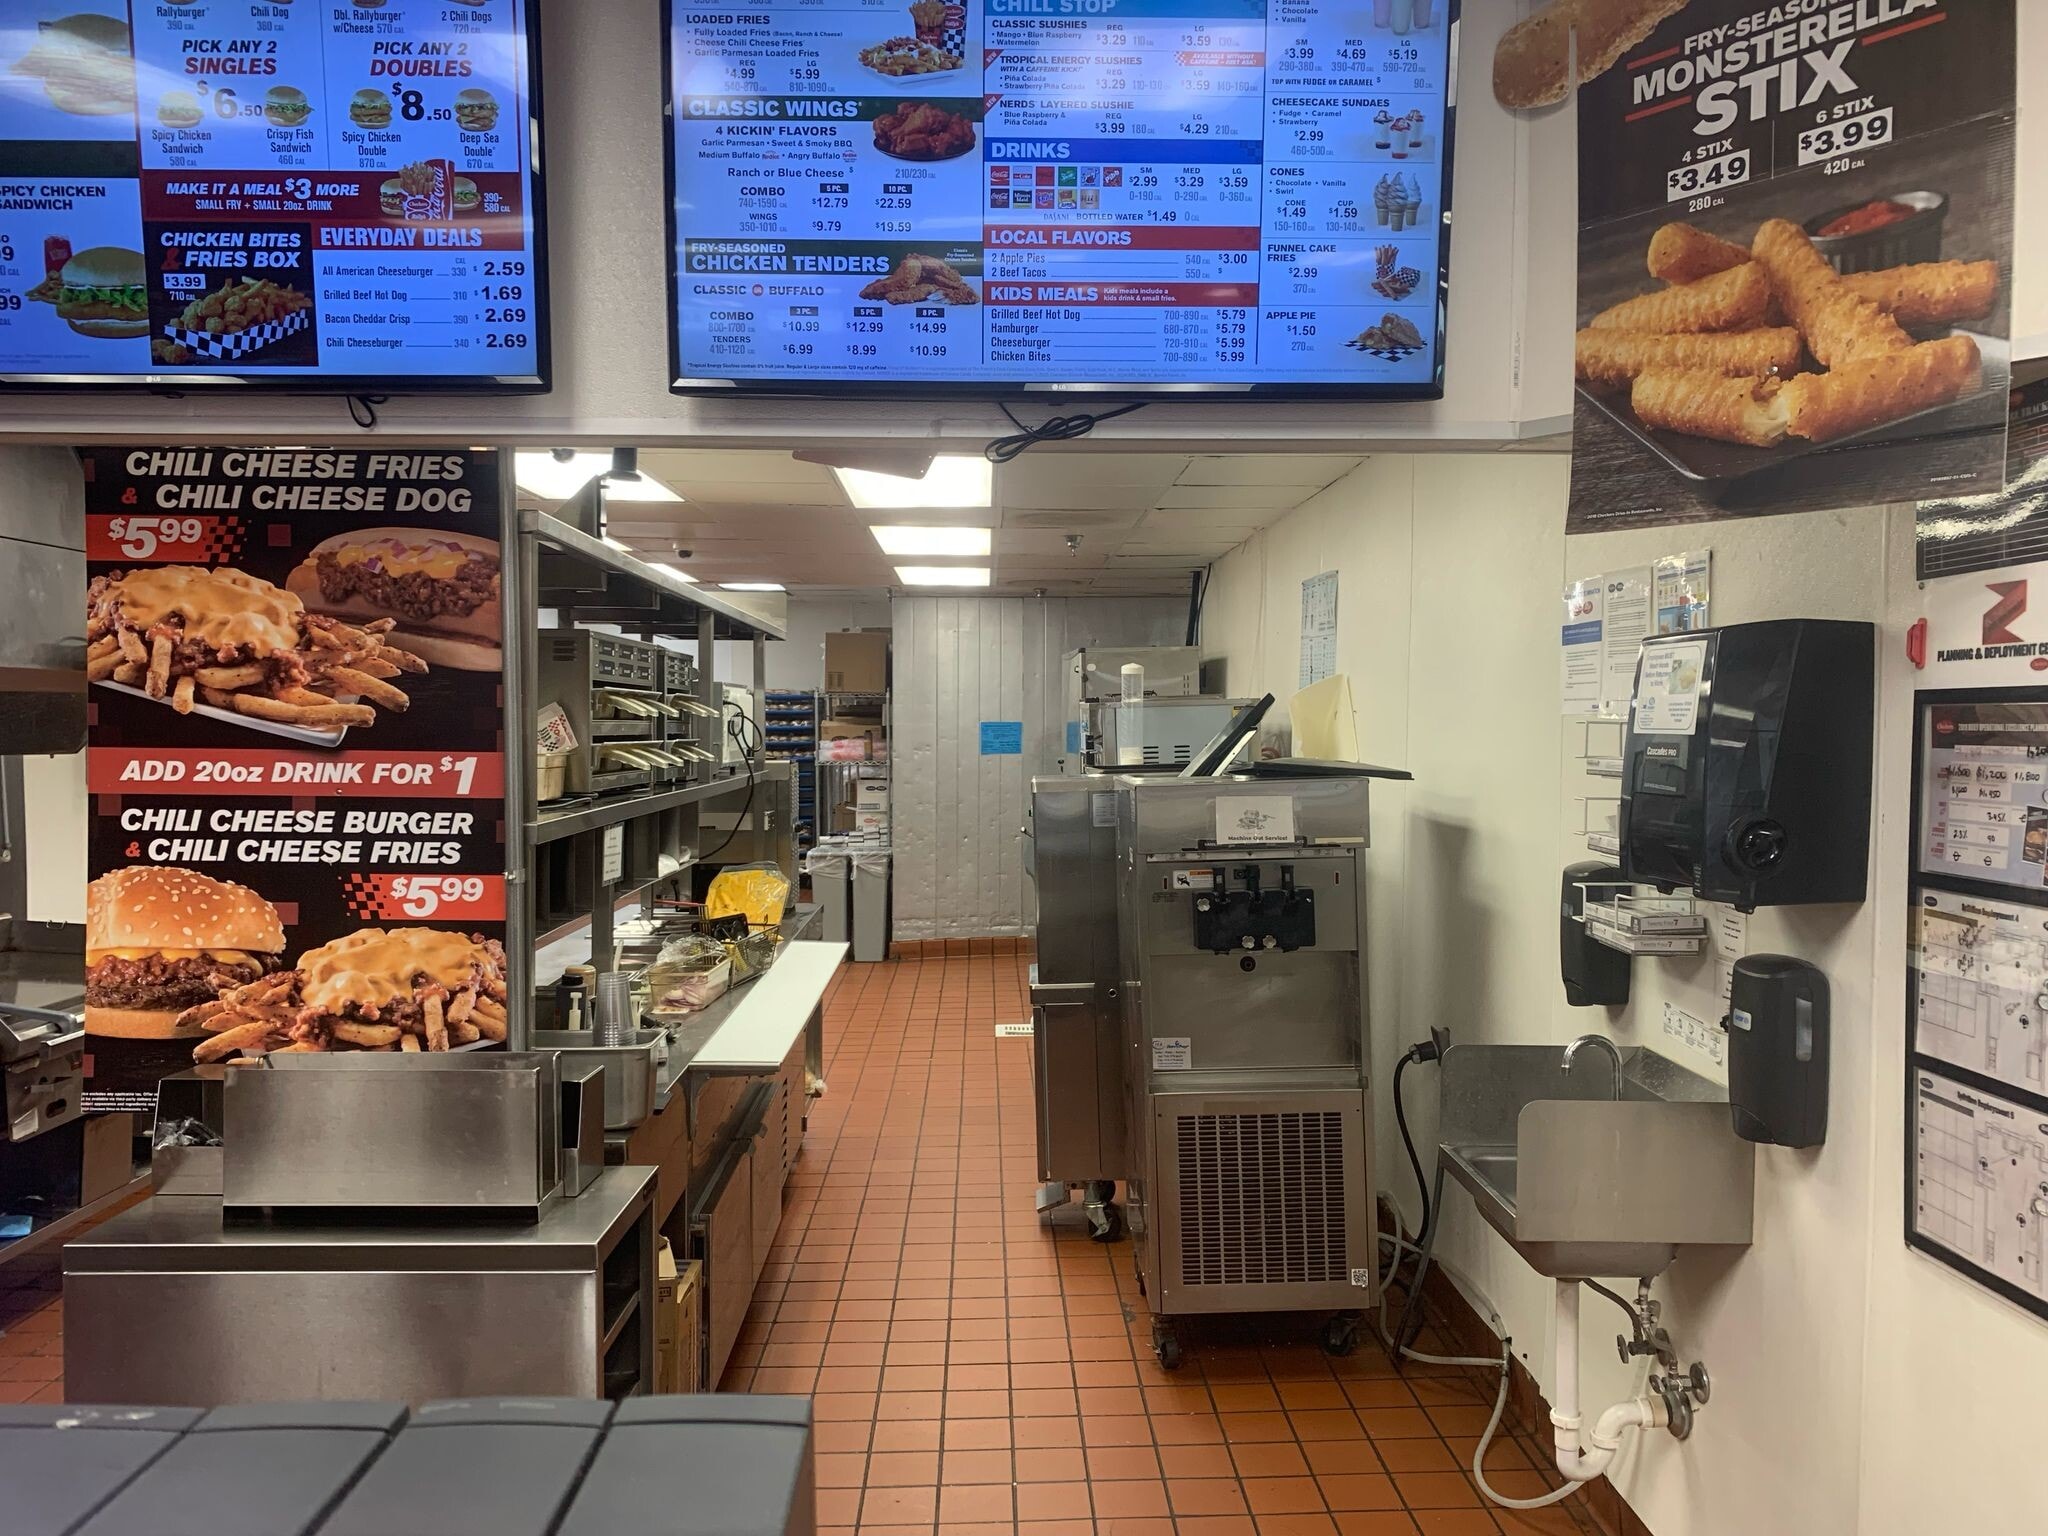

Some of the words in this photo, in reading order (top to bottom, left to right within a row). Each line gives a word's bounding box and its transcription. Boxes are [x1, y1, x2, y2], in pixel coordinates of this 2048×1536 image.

[993, 0, 1053, 12] CHILL
[1060, 0, 1115, 13] STOP
[687, 15, 734, 25] LOADED
[737, 15, 770, 25] FRIES
[992, 20, 1036, 29] CLASSIC
[1039, 20, 1087, 29] SLUSHIES
[717, 29, 748, 37] Loaded
[750, 29, 771, 37] Fries
[182, 40, 224, 53] PICK
[230, 41, 262, 53] ANY
[267, 41, 277, 53] 2
[373, 42, 413, 55] PICK
[418, 42, 453, 55] ANY
[456, 43, 468, 55] 2
[766, 49, 797, 57] Loaded
[185, 57, 277, 75] SINGLES
[370, 59, 473, 77] DOUBLES
[1692, 39, 1858, 136] STIX
[689, 100, 780, 117] CLASSIC
[1272, 98, 1339, 106] CHEESECAKE
[1342, 99, 1389, 107] SUNDAES
[1816, 110, 1827, 123] 6
[1832, 97, 1874, 120] STIX
[152, 129, 175, 142] Spicy
[178, 129, 212, 141] Chicken
[267, 129, 293, 142] Crispy
[296, 129, 314, 140] Fish
[342, 131, 366, 144] Spicy
[368, 132, 401, 143] Chicken
[716, 127, 723, 136] 4
[727, 126, 775, 136] KICKIN'
[779, 127, 837, 136] FLAVORS
[1801, 116, 1888, 153] $3.99
[460, 133, 482, 145] Deep
[484, 134, 499, 144] Sea
[162, 142, 203, 155] Sandwich
[271, 142, 311, 154] Sandwich
[991, 143, 1071, 158] DRINKS
[1682, 151, 1691, 163] 4
[1696, 139, 1733, 160] STIX
[1270, 168, 1304, 176] CONES
[1824, 158, 1850, 174] 420
[1852, 159, 1865, 168] CAL
[728, 168, 761, 177] Ranch
[777, 168, 800, 177] Blue
[802, 168, 844, 178] Cheese
[1669, 156, 1746, 191] $3.49
[41, 186, 105, 197] CHICKEN
[166, 183, 208, 195] MAKE
[212, 183, 224, 195] IT
[229, 184, 240, 195] A
[243, 184, 282, 195] MEAL
[285, 178, 311, 200] $3
[316, 183, 359, 196] MORE
[741, 187, 785, 196] COMBO
[195, 200, 223, 210] SMALL
[226, 200, 242, 210] FRY
[253, 200, 281, 210] SMALL
[307, 201, 332, 211] DRINK
[1689, 197, 1710, 212] 280
[1712, 197, 1724, 206] CAL
[161, 232, 243, 247] CHICKEN
[249, 234, 301, 247] BITES
[321, 228, 416, 247] EVERYDAY
[424, 228, 482, 247] DEALS
[991, 230, 1047, 244] LOCAL
[1052, 231, 1132, 245] FLAVORS
[691, 243, 786, 253] FRY-SEASONED
[185, 251, 247, 267] FRIES
[254, 252, 300, 268] BOX
[692, 255, 787, 271] CHICKEN
[792, 256, 889, 272] TENDERS
[1000, 268, 1020, 277] Beef
[1022, 268, 1046, 277] Tacos
[694, 285, 746, 294] CLASSIC
[769, 286, 824, 295] BUFFALO
[991, 287, 1033, 300] KIDS
[1038, 288, 1098, 301] MEALS
[710, 311, 754, 321] COMBO
[991, 309, 1020, 320] Grilled
[1023, 309, 1043, 320] Beef
[1046, 310, 1061, 320] Hot
[1064, 310, 1080, 321] Dog
[991, 323, 1039, 334] Hamburger
[991, 337, 1051, 348] Cheeseburger
[991, 351, 1026, 361] Chicken
[1029, 352, 1051, 362] Bites
[126, 451, 210, 476] CHILI
[222, 453, 356, 478] CHEESE
[366, 456, 464, 479] FRIES
[121, 488, 137, 504] &
[156, 484, 242, 509] CHILI
[252, 486, 387, 511] CHEESE
[395, 488, 472, 512] DOG
[1937, 649, 1974, 662] PLANNING
[1975, 648, 1983, 659] &
[1985, 644, 2037, 658] DEPLOYMENT
[1647, 746, 1667, 756] Cascades
[120, 760, 186, 781] ADD
[193, 762, 262, 783] 20oz
[271, 762, 364, 783] DRINK
[371, 763, 433, 785] FOR
[440, 755, 477, 795] $1
[121, 808, 202, 831] CHILI
[209, 810, 335, 833] CHEESE
[343, 811, 474, 835] BURGER
[125, 842, 140, 857] &
[147, 838, 229, 862] CHILI
[236, 839, 363, 863] CHEESE
[369, 841, 462, 864] FRIES
